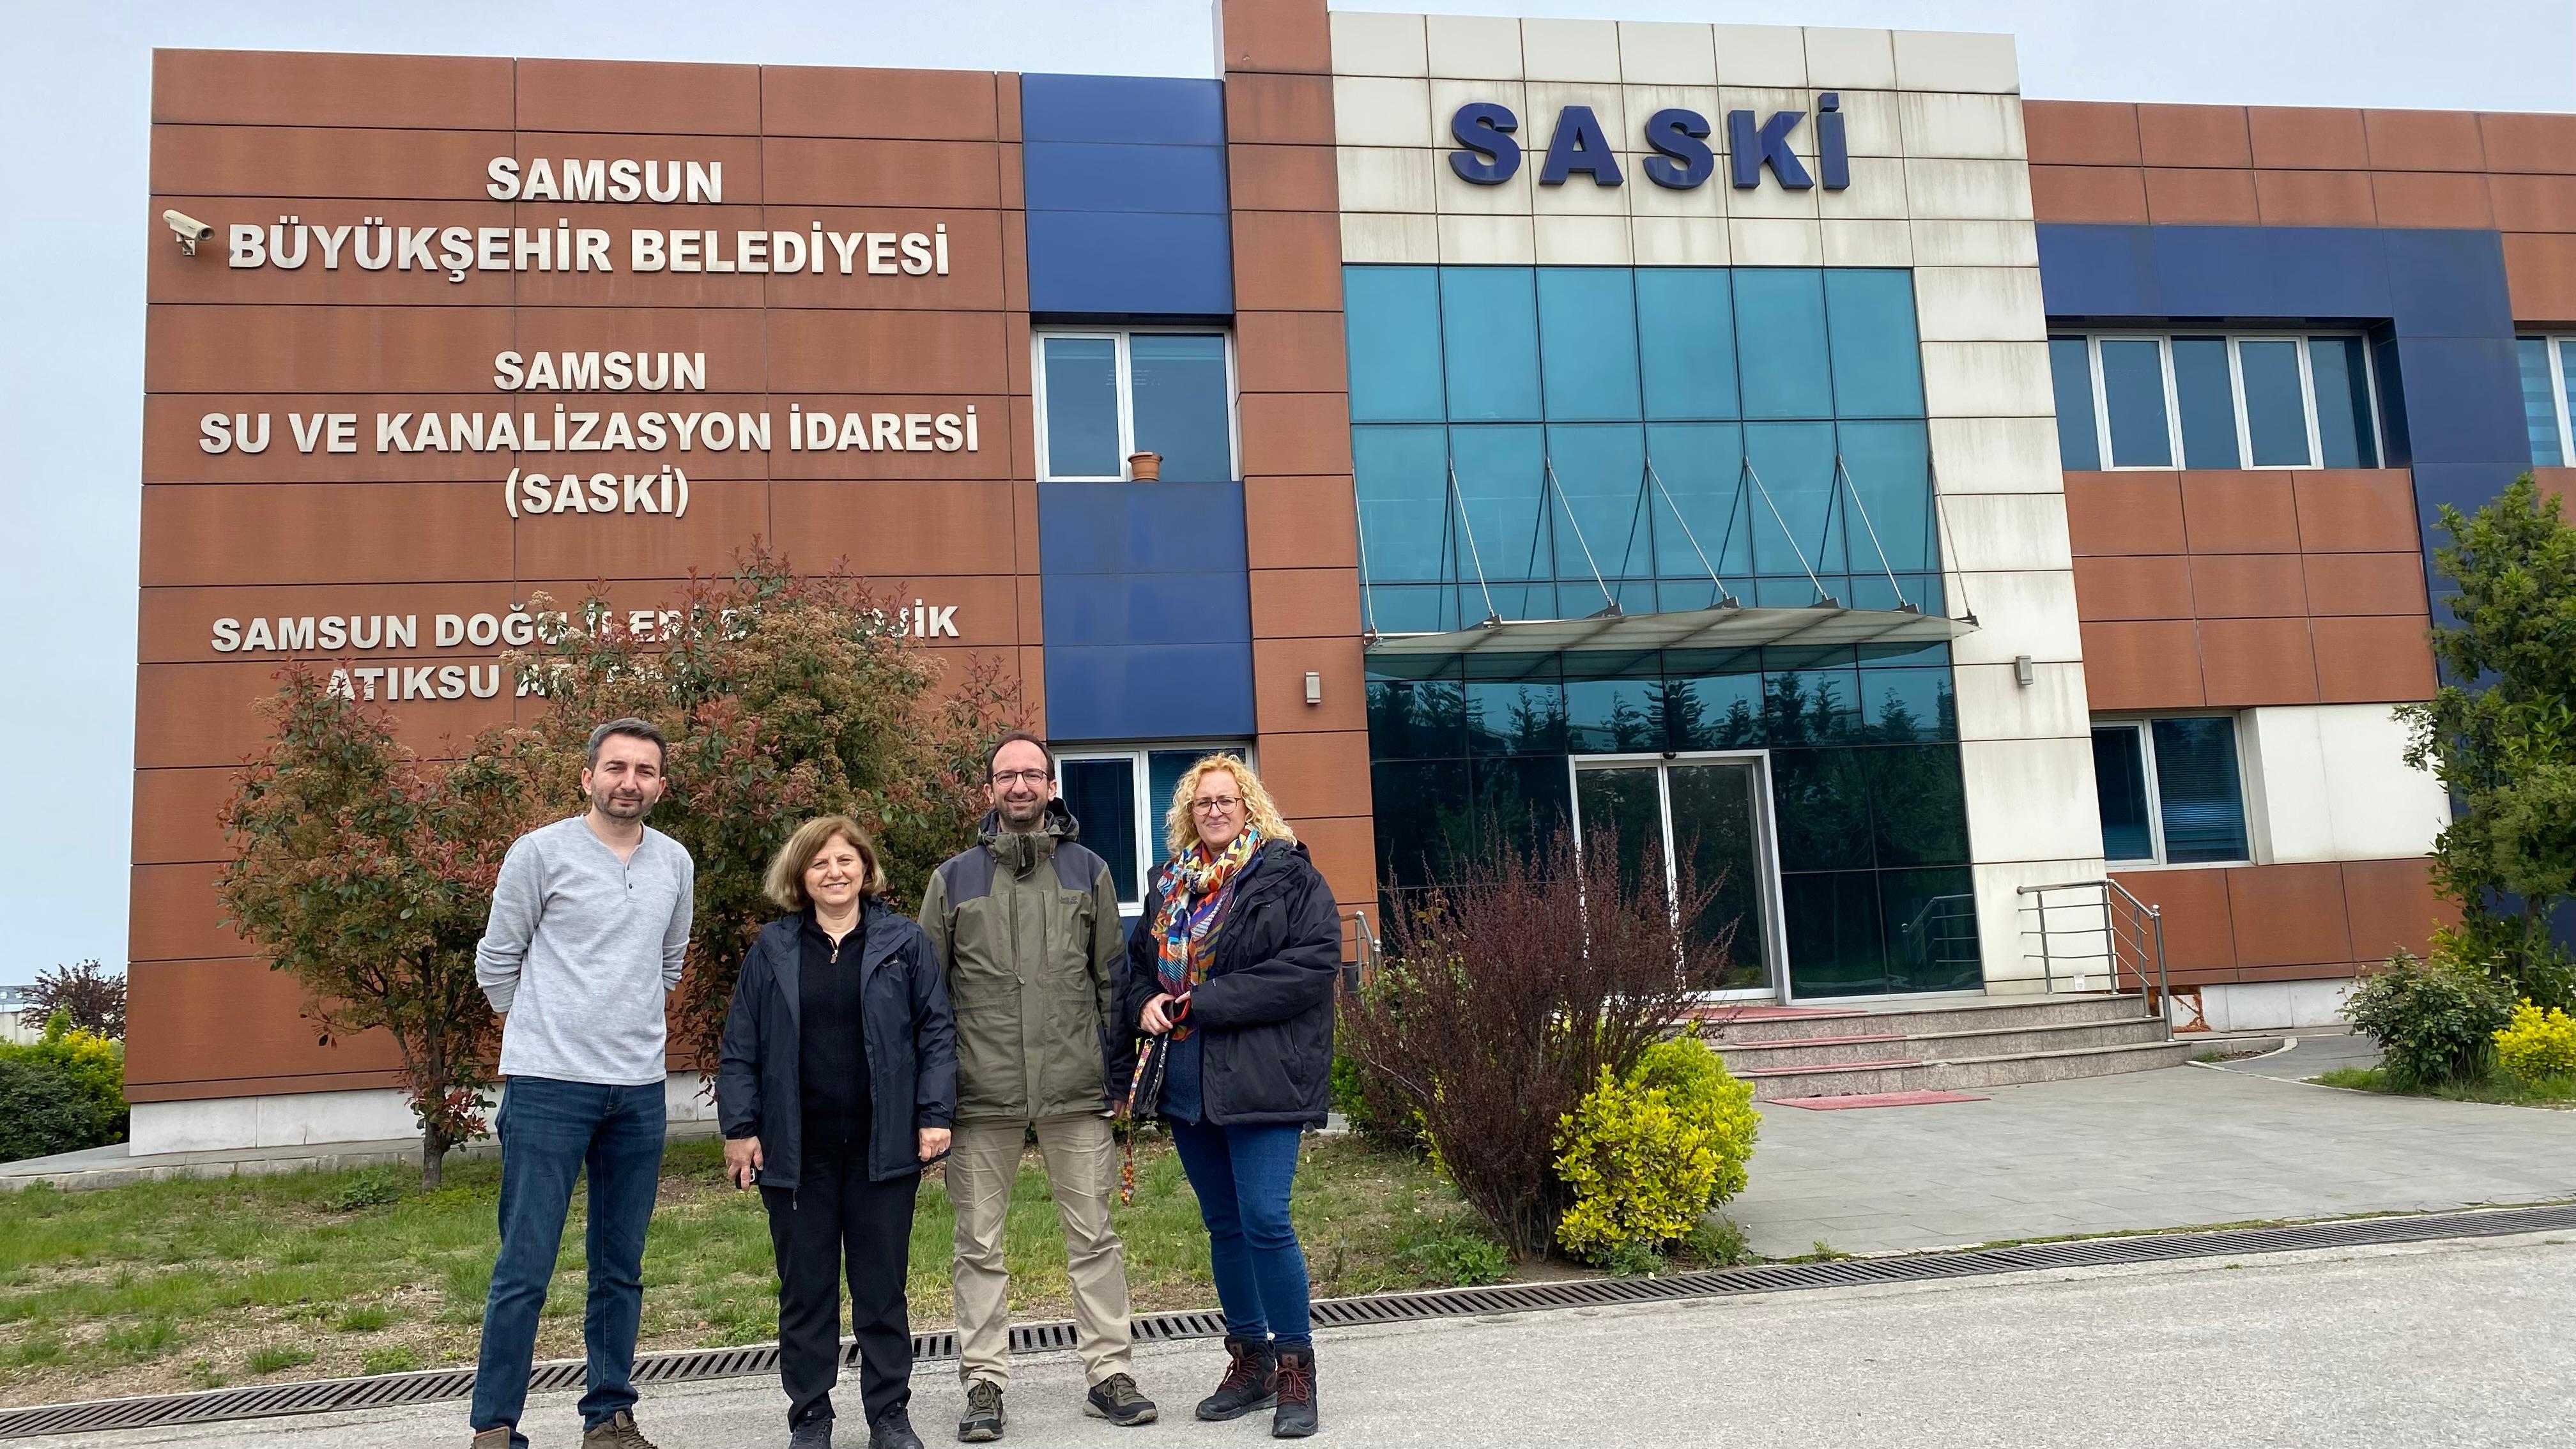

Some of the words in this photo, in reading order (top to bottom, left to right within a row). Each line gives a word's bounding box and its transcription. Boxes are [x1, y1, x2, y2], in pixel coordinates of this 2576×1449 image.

[1448, 92, 1850, 192] SASKİ
[486, 157, 723, 204] SAMSUN
[228, 215, 613, 283] BÜYÜKŞEHİR
[631, 221, 949, 275] BELEDİYESİ
[493, 351, 706, 391] SAMSUN
[199, 413, 271, 454] SU
[288, 412, 357, 453] VE
[376, 403, 772, 452] KANALİZASYON
[789, 403, 979, 452] İDARESİ
[504, 464, 689, 518] (SASKİ)
[211, 615, 417, 652] SAMSUN
[326, 664, 500, 701] ATIKSU
